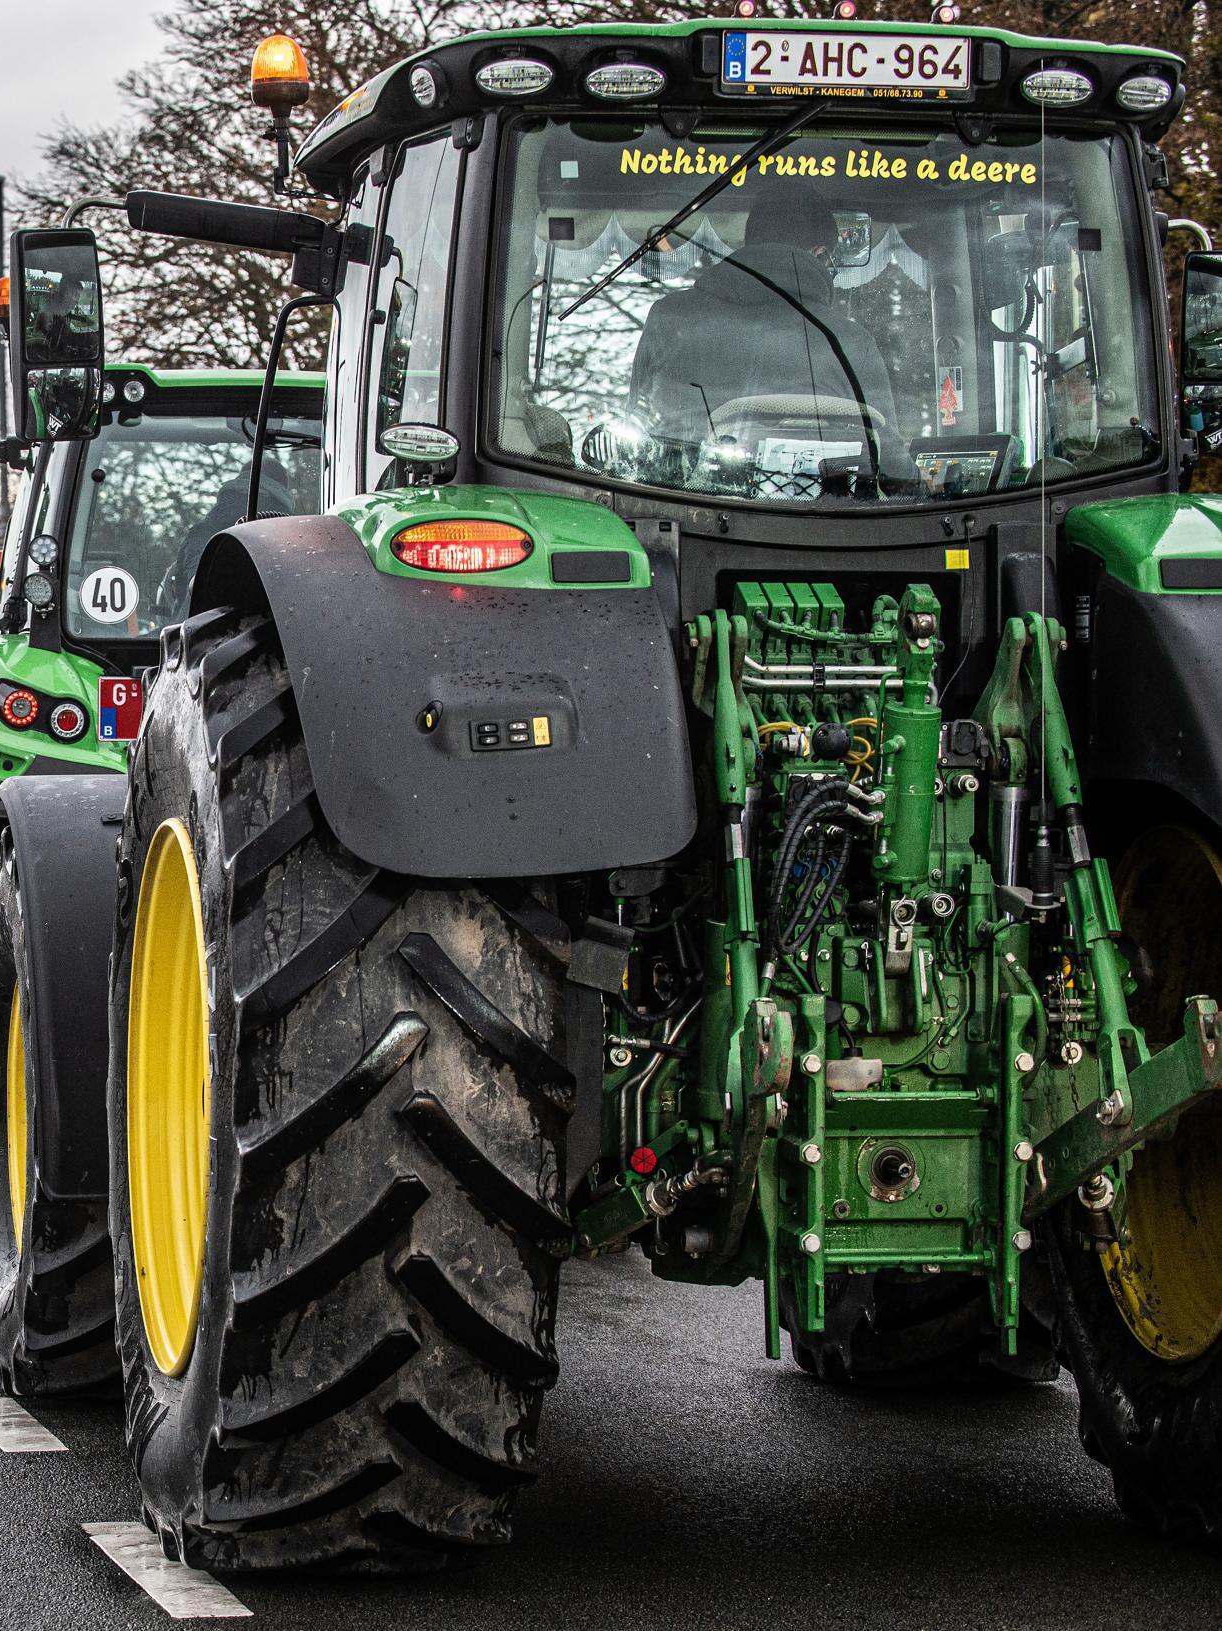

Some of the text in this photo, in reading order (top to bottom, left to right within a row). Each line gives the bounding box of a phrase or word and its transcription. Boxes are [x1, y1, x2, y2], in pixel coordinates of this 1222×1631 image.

[729, 61, 742, 79] B
[770, 86, 814, 95] VERWILST
[821, 88, 865, 97] KANEGEM
[873, 89, 923, 98] 051/68.73.90
[758, 154, 836, 176] runs
[845, 150, 907, 179] like
[916, 159, 940, 180] a
[948, 153, 1037, 184] deere
[92, 577, 126, 613] 40
[103, 725, 113, 736] B
